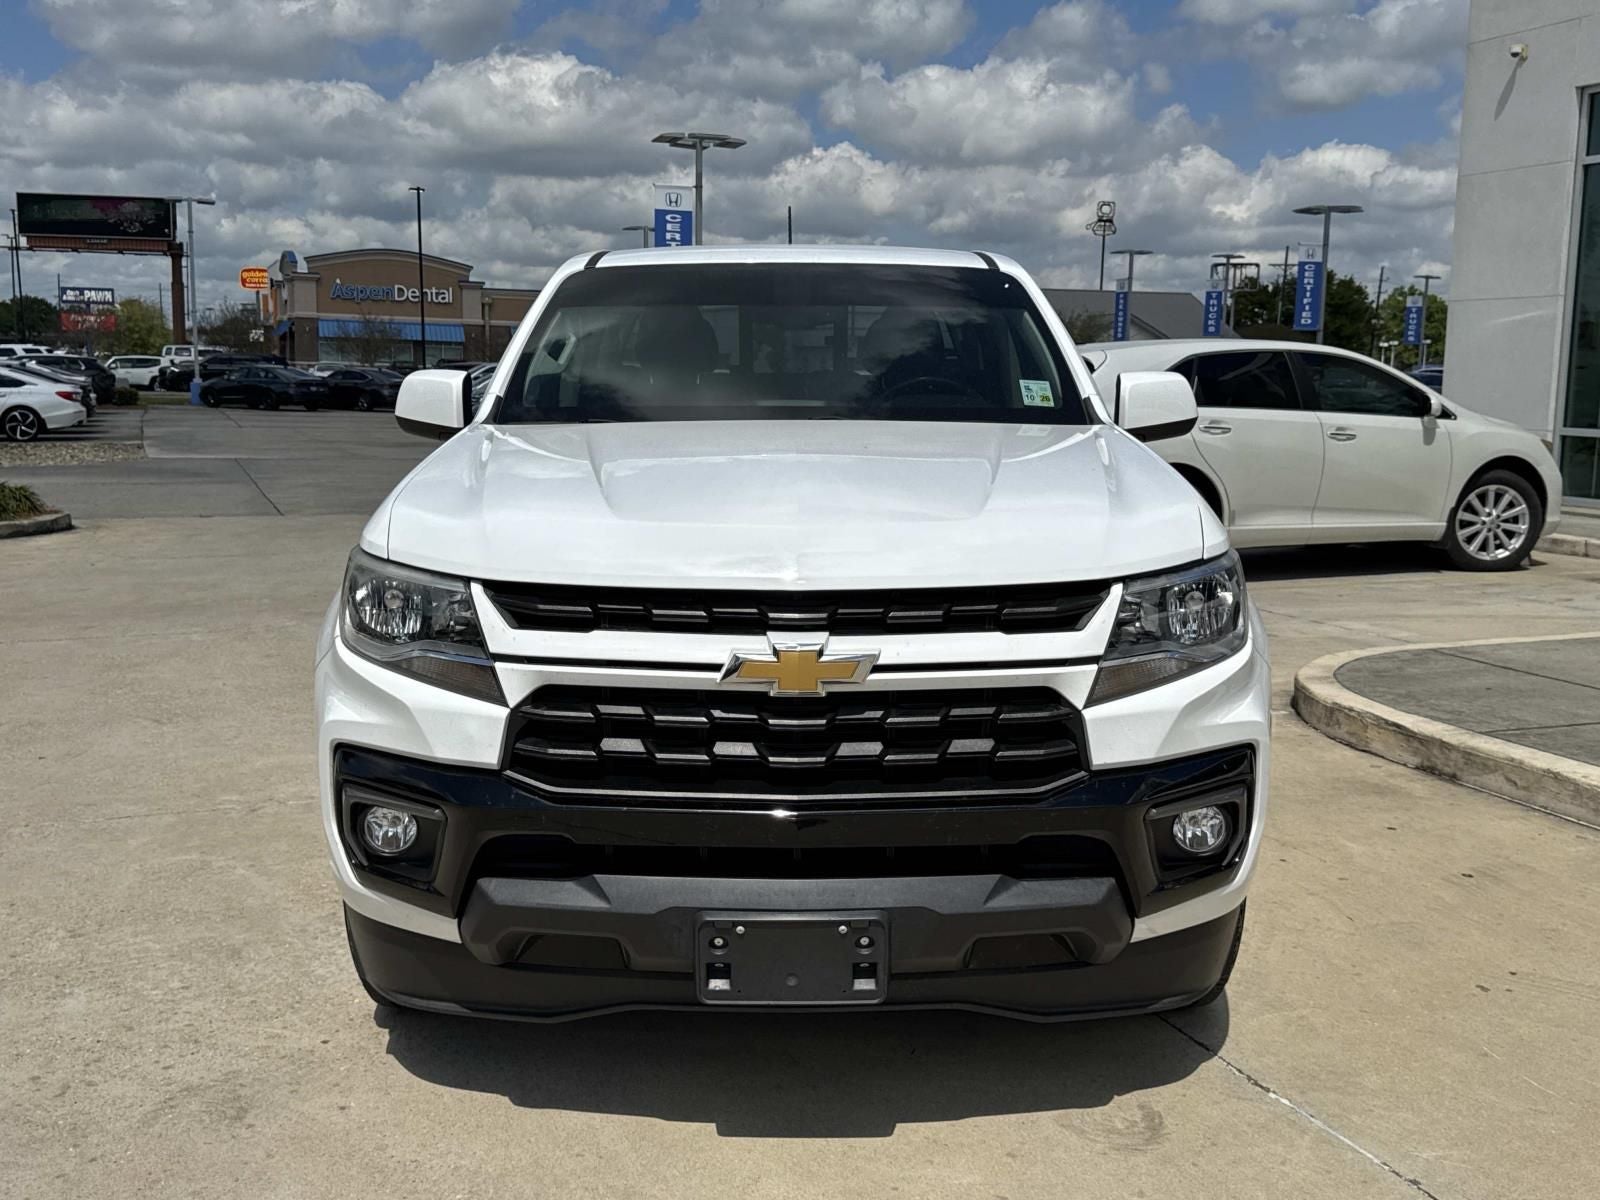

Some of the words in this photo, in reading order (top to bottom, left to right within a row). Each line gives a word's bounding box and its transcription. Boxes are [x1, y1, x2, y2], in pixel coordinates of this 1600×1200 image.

[241, 270, 269, 279] golden
[84, 290, 112, 302] PAWN
[330, 278, 453, 303] AspenDental
[1300, 264, 1316, 325] CERTIFIED
